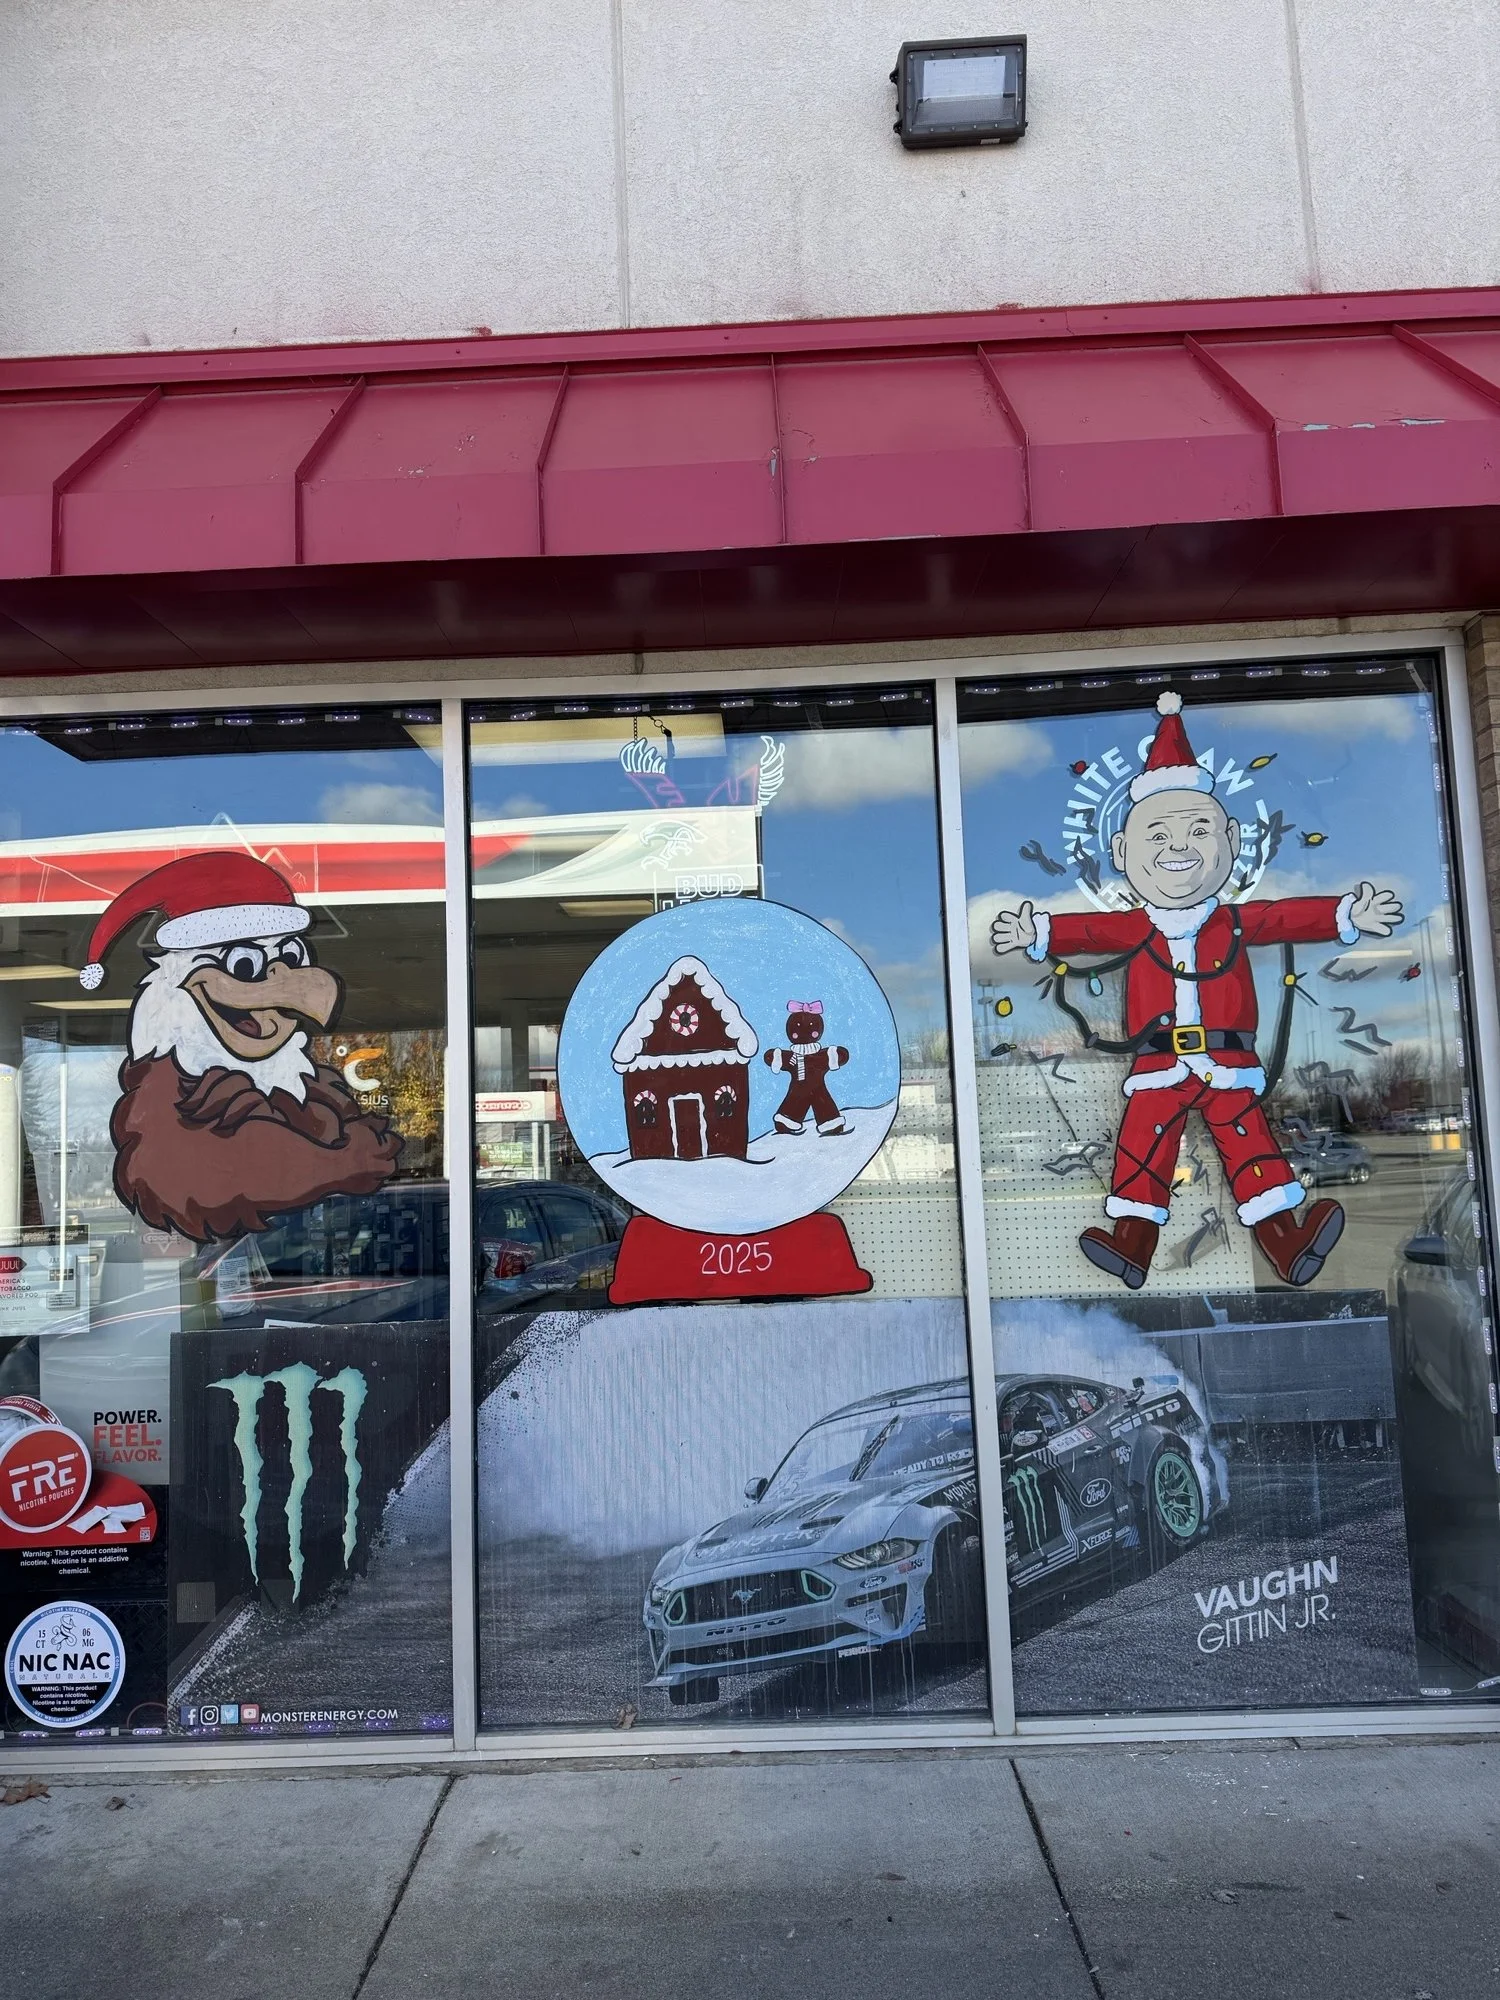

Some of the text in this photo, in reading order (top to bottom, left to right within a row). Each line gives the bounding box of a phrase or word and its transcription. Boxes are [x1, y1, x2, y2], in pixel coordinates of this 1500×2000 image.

[1137, 735, 1255, 796] CAW
[675, 873, 744, 899] BUD
[700, 1241, 772, 1275] 2025
[93, 1410, 162, 1425] POWER.
[93, 1424, 162, 1448] FEEL.
[92, 1448, 162, 1464] FLAVOR.
[9, 1452, 77, 1502] FRE
[18, 1486, 75, 1512] NICOTINE POUCHES
[22, 1550, 53, 1558] Warning:
[71, 1548, 97, 1556] product
[98, 1546, 128, 1554] contains
[51, 1557, 79, 1565] Nicotine
[98, 1555, 129, 1563] addictive
[58, 1567, 91, 1575] chemical.
[1193, 1555, 1339, 1618] VAUGHN
[1197, 1593, 1336, 1653] GITTIN JR.
[38, 1629, 46, 1638] 15
[82, 1628, 91, 1637] 06
[35, 1640, 46, 1649] CT
[82, 1638, 95, 1647] MG
[19, 1651, 111, 1673] NIC NAC
[260, 1708, 399, 1723] MONSTERENERGY.COM
